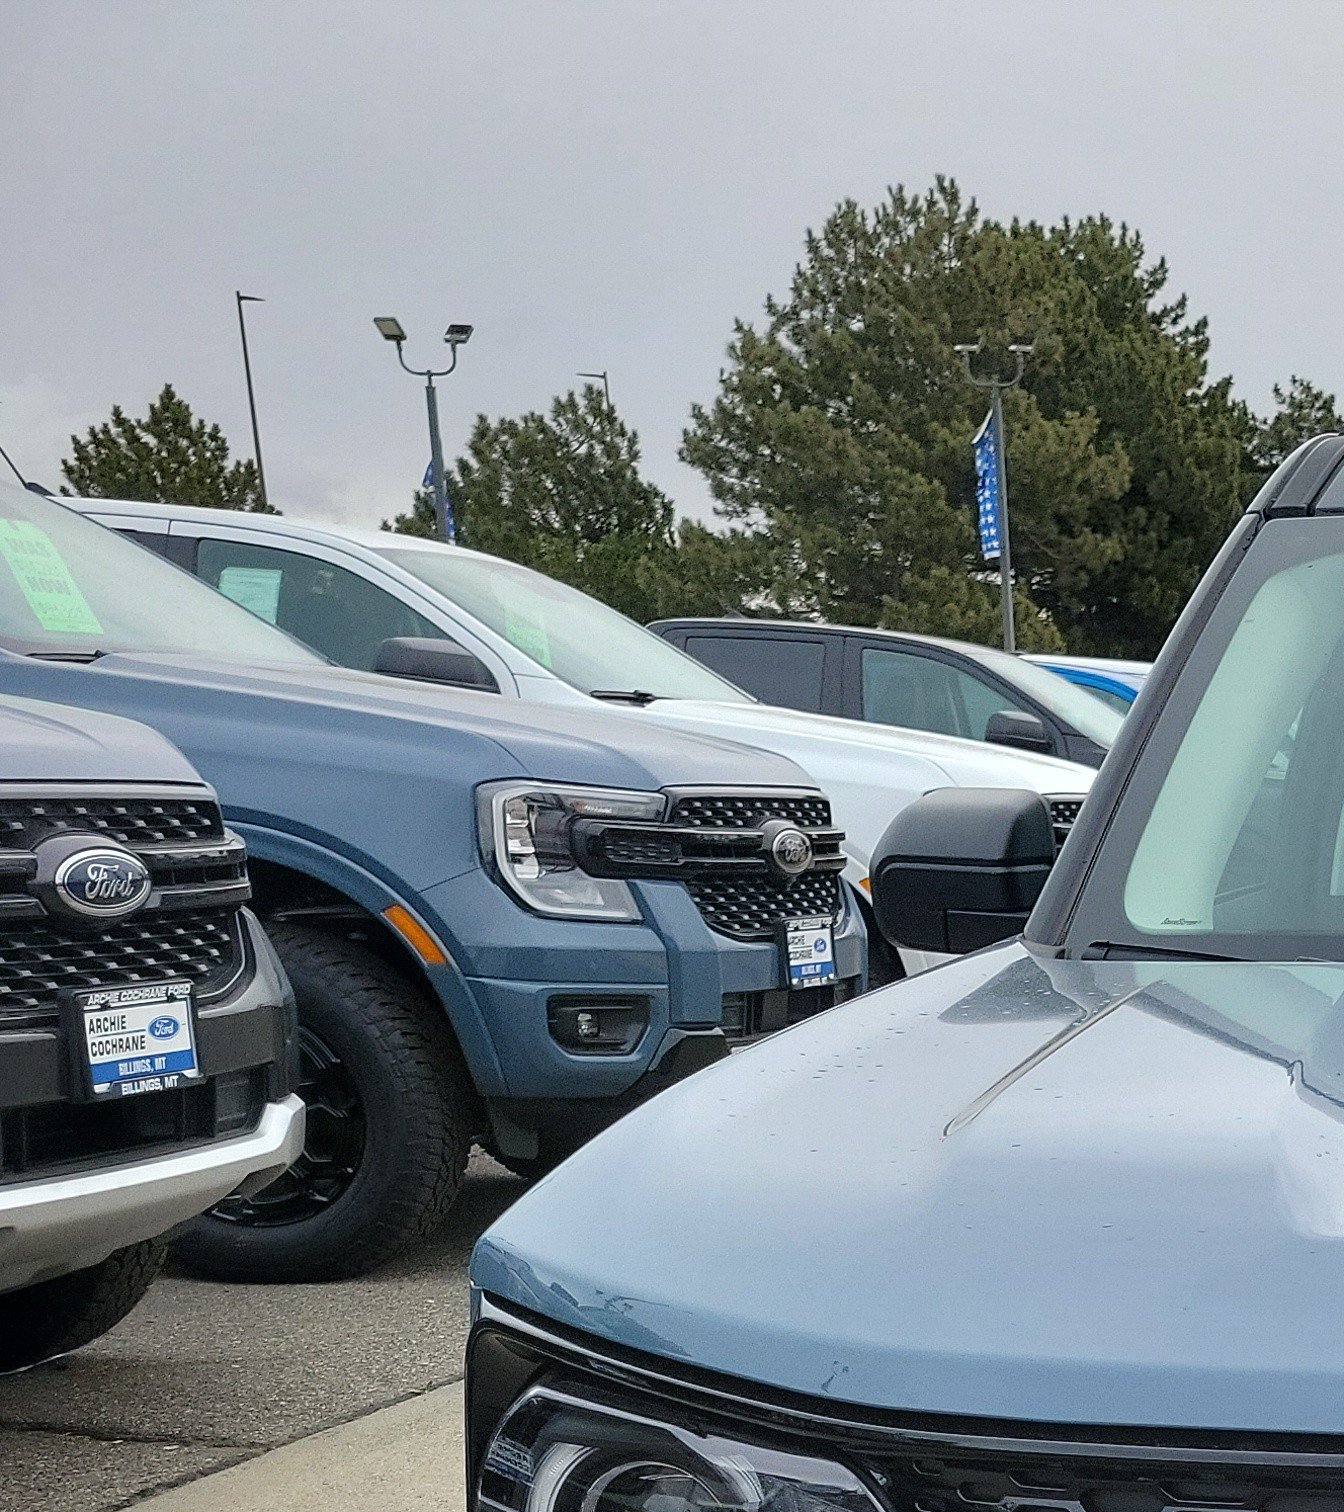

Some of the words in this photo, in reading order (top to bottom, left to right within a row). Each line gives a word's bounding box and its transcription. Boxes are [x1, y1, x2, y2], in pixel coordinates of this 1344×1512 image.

[85, 863, 135, 899] Ford
[120, 987, 167, 1001] COCHRANE
[167, 984, 191, 996] FORD
[88, 1014, 127, 1035] ARCHIE
[154, 1019, 174, 1036] Ford
[90, 1034, 146, 1058] COCHRANE
[154, 1057, 167, 1070] MT
[164, 1075, 179, 1089] MT
